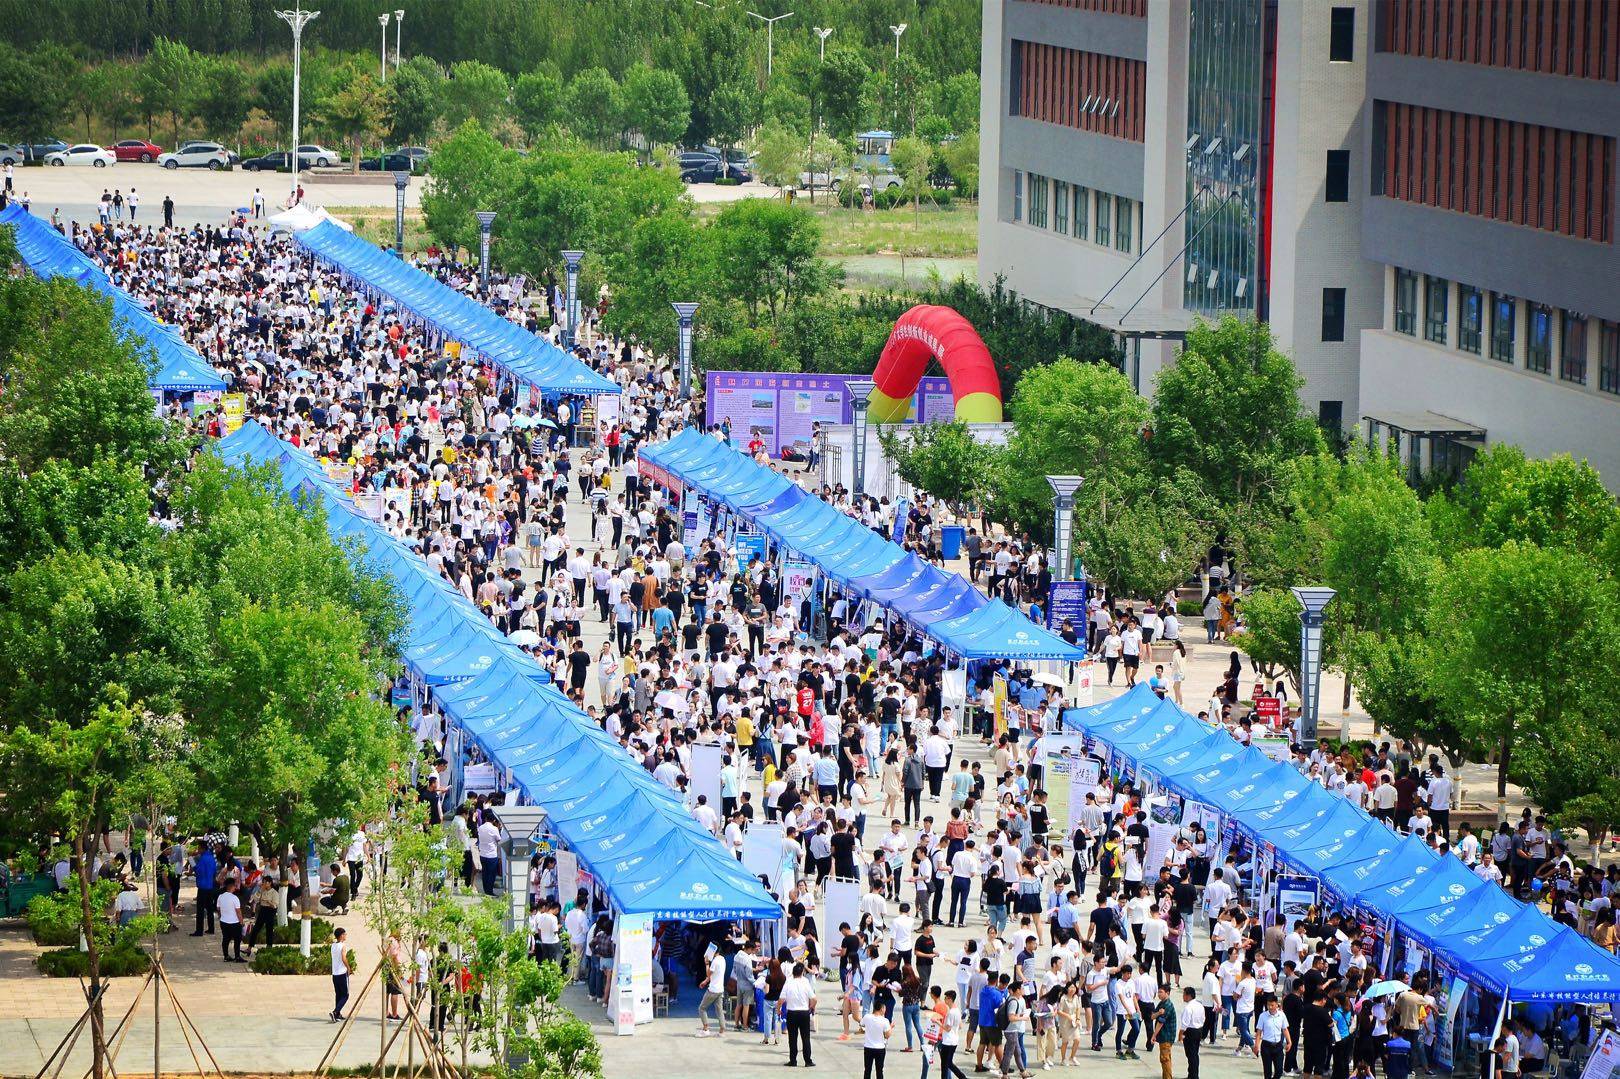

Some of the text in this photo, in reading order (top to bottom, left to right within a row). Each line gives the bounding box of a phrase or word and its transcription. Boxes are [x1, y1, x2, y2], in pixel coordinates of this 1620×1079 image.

[653, 909, 753, 919] 东省技能型人才培养特色名校
